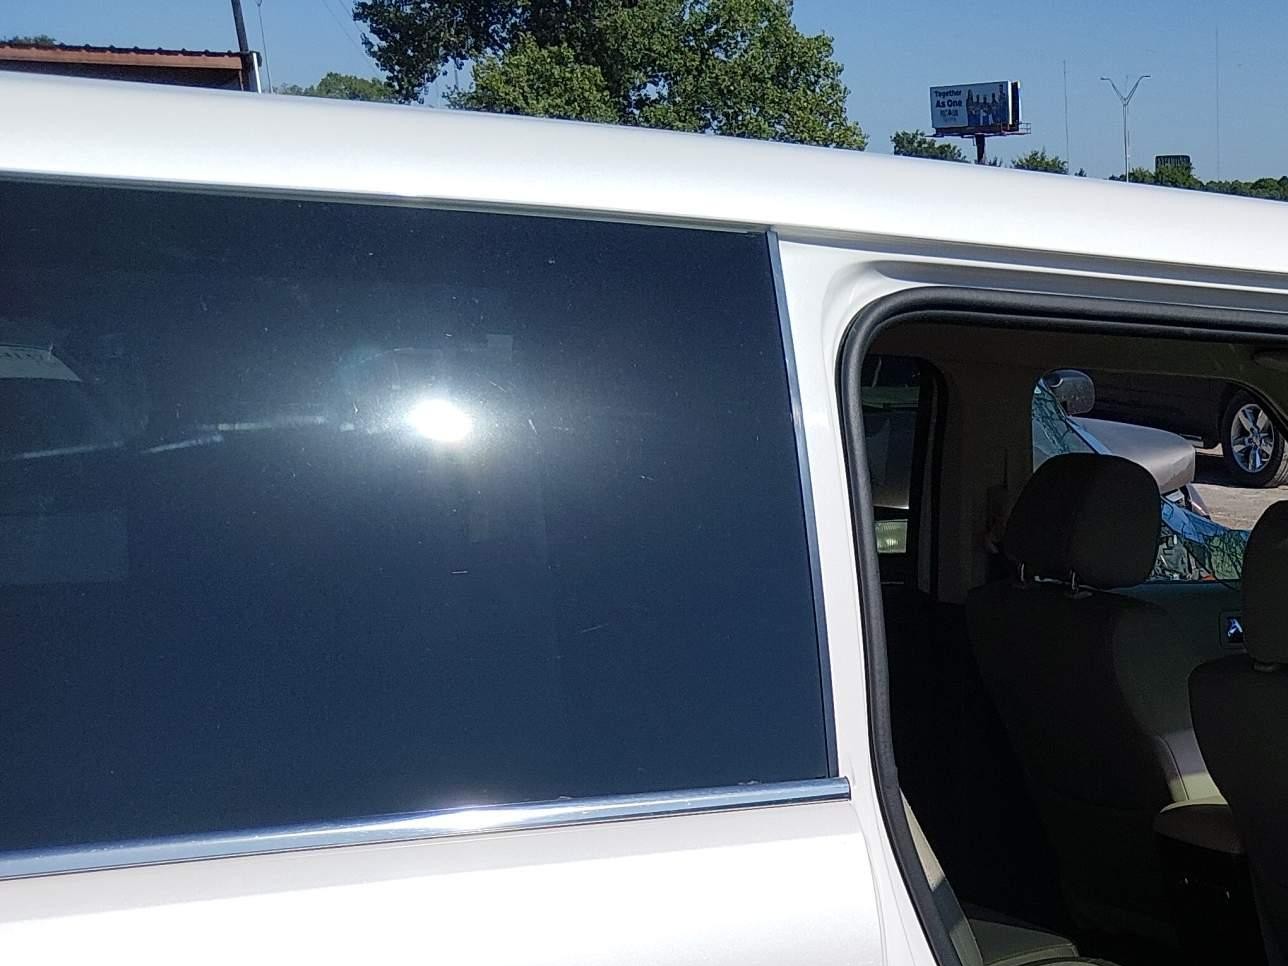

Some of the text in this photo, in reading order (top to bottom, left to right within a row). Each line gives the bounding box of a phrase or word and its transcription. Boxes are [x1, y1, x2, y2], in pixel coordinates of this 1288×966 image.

[934, 90, 962, 98] Together
[936, 99, 963, 108] As One
